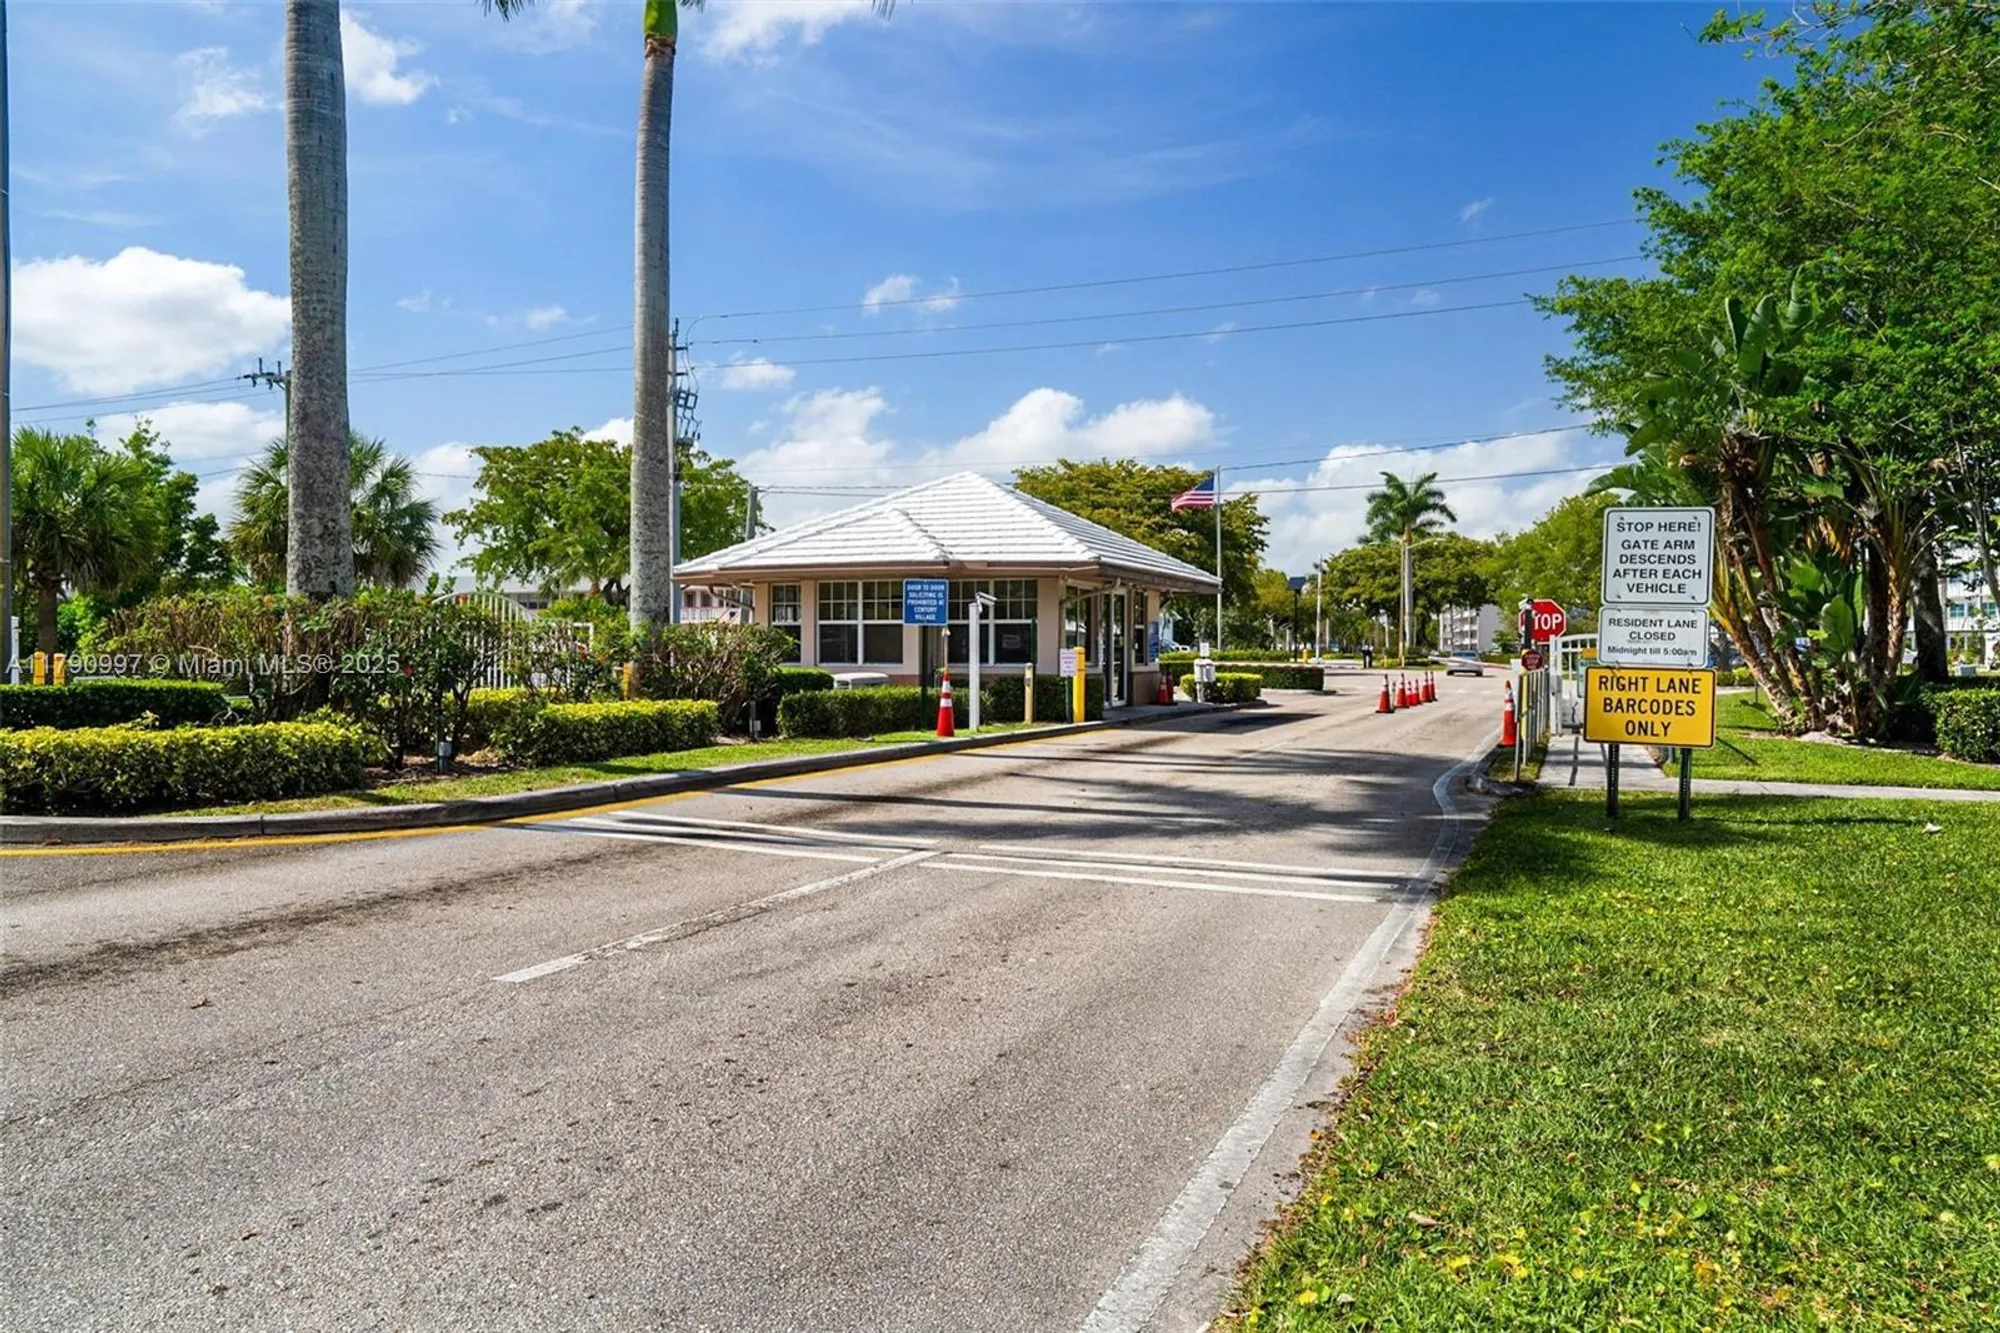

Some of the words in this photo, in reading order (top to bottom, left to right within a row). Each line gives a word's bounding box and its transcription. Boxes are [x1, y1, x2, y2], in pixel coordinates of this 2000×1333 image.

[1616, 522, 1654, 533] STOP
[1658, 522, 1701, 533] HERE!
[1621, 539, 1659, 550] GATE
[1663, 539, 1696, 550] ARM
[1619, 554, 1697, 565] DESCENDS
[1612, 568, 1658, 579] AFTER
[1662, 568, 1702, 579] EACH
[1627, 583, 1687, 594] VEHICLE
[1521, 613, 1562, 630] TOP
[1608, 618, 1664, 628] RESIDENT
[1667, 619, 1698, 629] LANE
[1629, 631, 1676, 641] CLOSED
[1607, 646, 1647, 656] Midnight
[1649, 647, 1661, 655] till
[1598, 675, 1649, 693] RIGHT
[1656, 677, 1702, 694] LANE
[1603, 697, 1696, 716] BARCODES
[1624, 719, 1672, 737] ONLY
